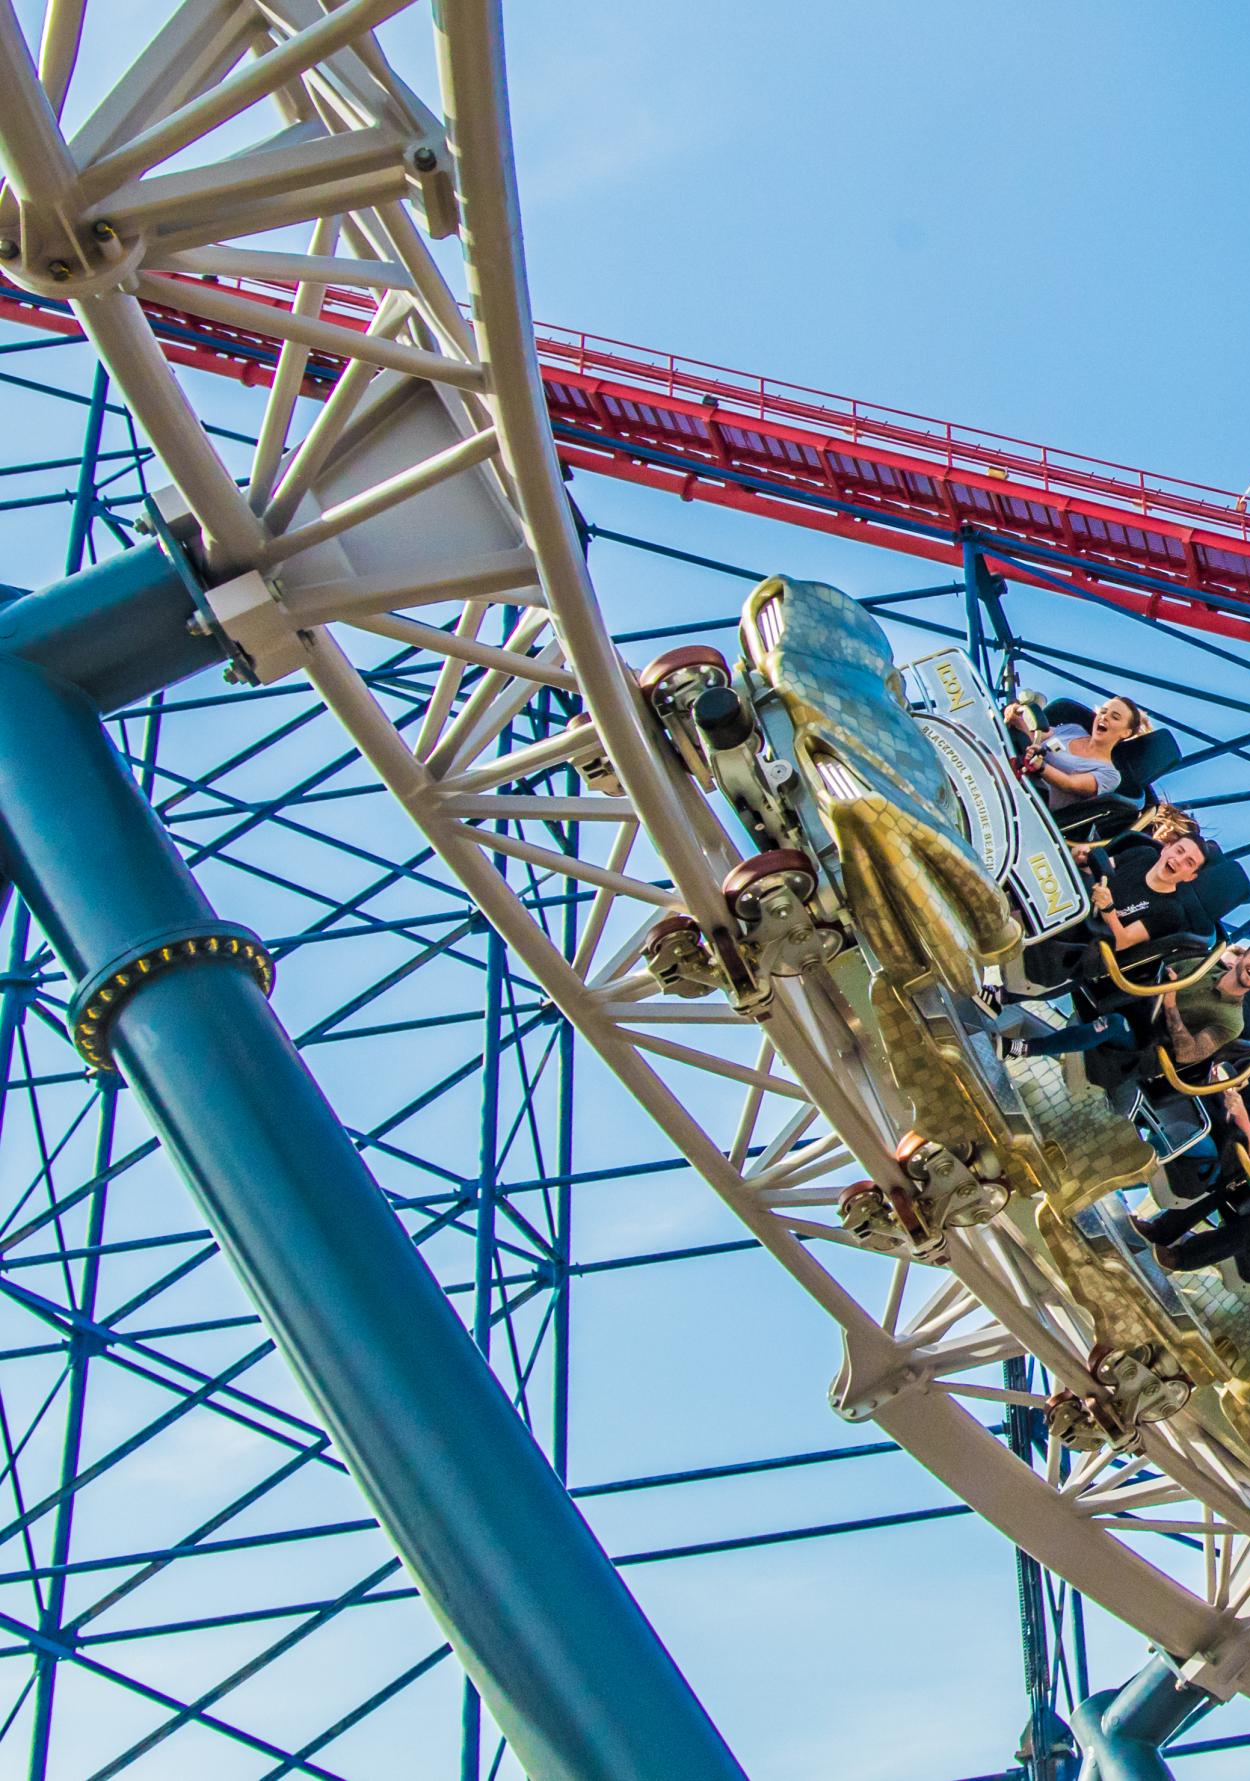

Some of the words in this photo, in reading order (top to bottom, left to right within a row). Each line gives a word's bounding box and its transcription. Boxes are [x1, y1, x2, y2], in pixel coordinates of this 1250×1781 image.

[935, 661, 975, 712] ICON
[921, 725, 967, 773] BLACKPOOL
[964, 775, 989, 829] PLEASURE
[984, 833, 995, 872] BEACH
[1028, 853, 1073, 916] ICON
